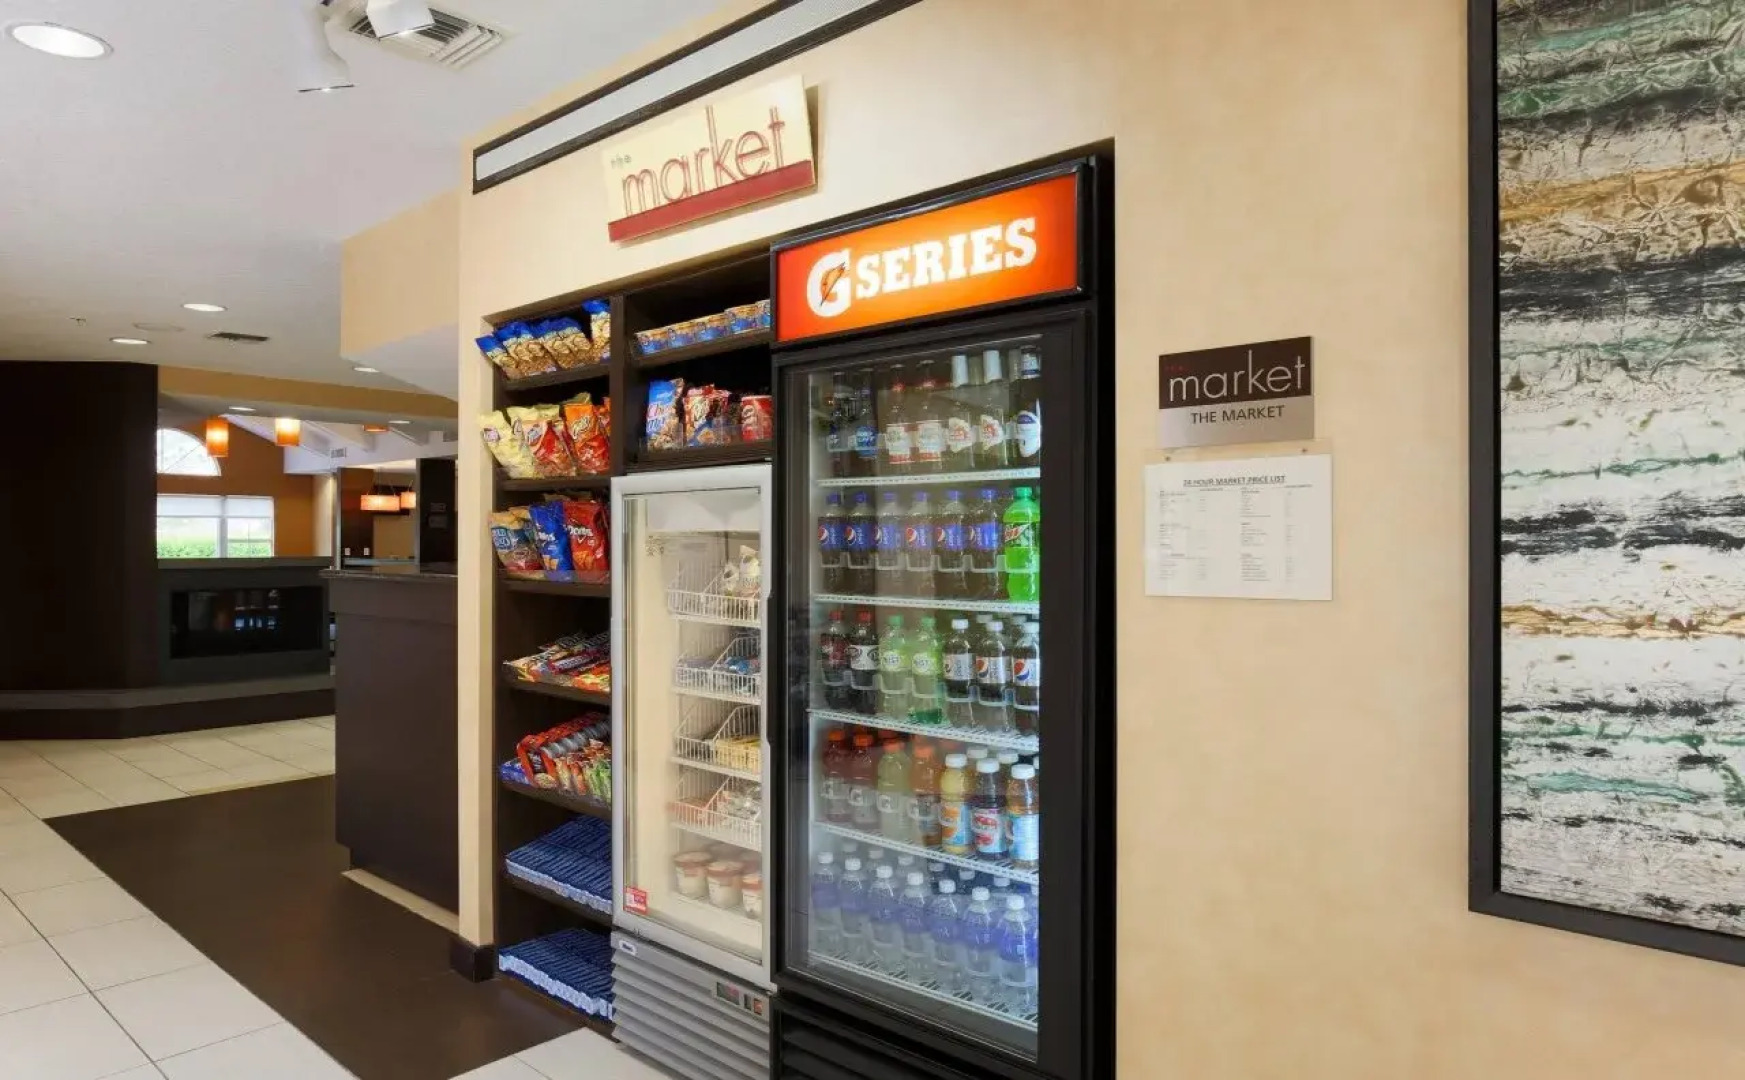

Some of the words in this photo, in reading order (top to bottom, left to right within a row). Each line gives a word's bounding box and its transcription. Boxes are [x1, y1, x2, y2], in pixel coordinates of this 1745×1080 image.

[621, 104, 786, 216] market
[806, 248, 851, 318] G
[856, 216, 1037, 300] SERIES
[1169, 349, 1306, 402] market
[1191, 410, 1217, 424] THE
[1222, 404, 1286, 422] MARKET
[1193, 478, 1214, 487] HOUR
[1215, 476, 1246, 486] MARKET
[1248, 475, 1269, 485] PRICE
[1270, 475, 1286, 484] LIST
